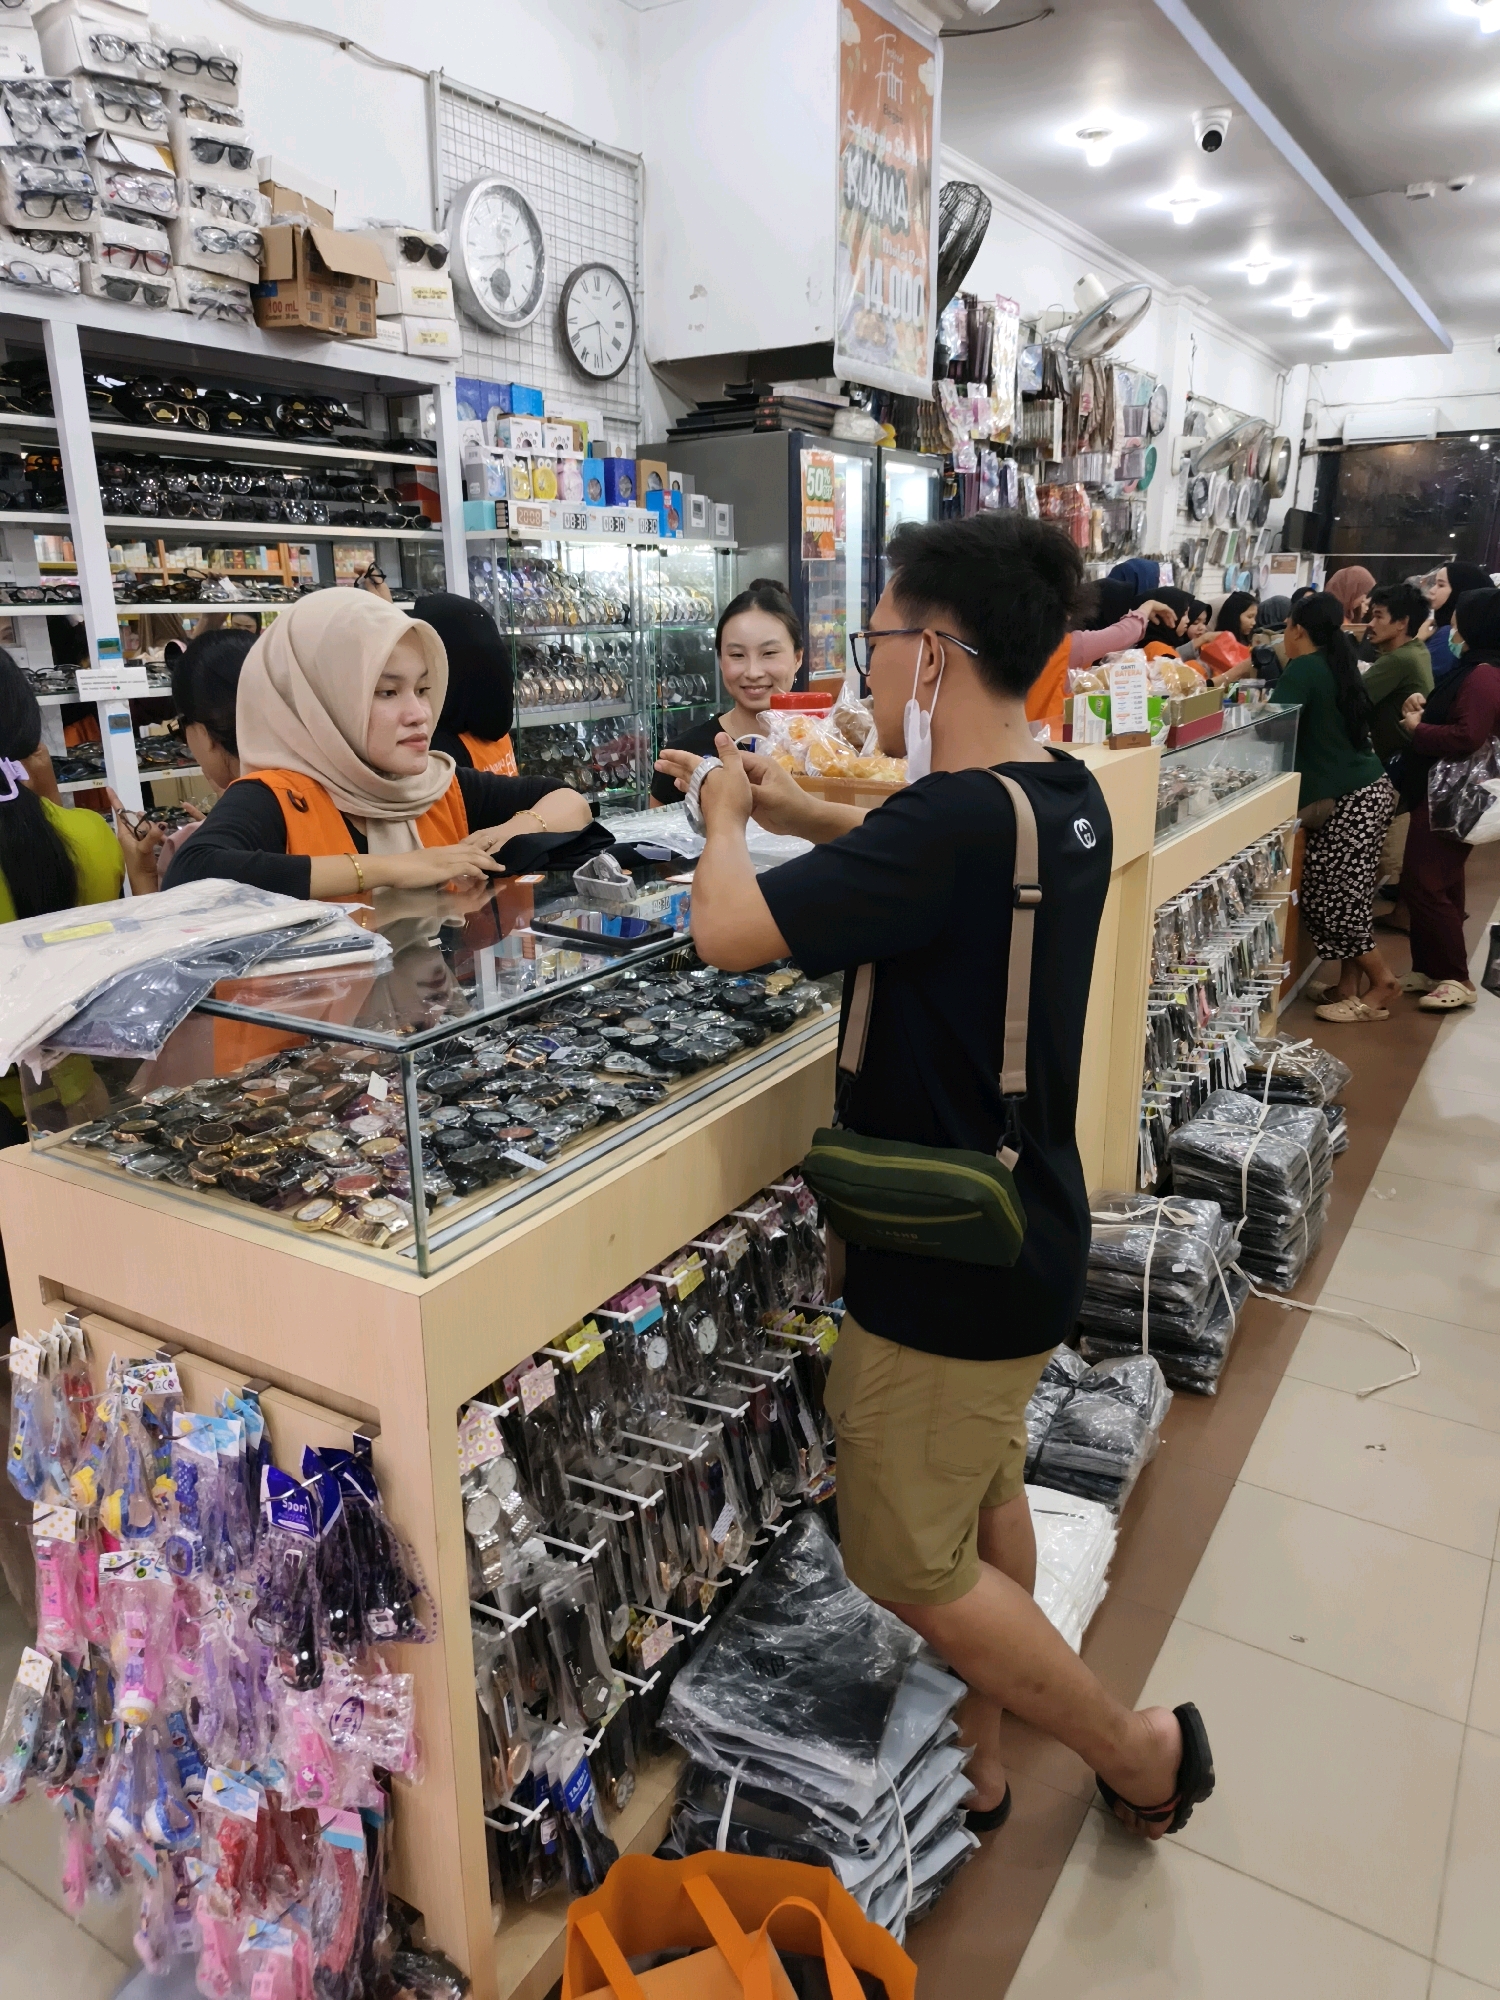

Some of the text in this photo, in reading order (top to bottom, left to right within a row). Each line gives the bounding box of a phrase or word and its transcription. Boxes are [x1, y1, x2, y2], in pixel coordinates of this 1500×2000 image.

[846, 149, 909, 230] KURMA
[862, 254, 925, 327] 14.000
[285, 300, 299, 312] mL
[806, 516, 834, 533] KURMA
[282, 1497, 308, 1515] Sport
